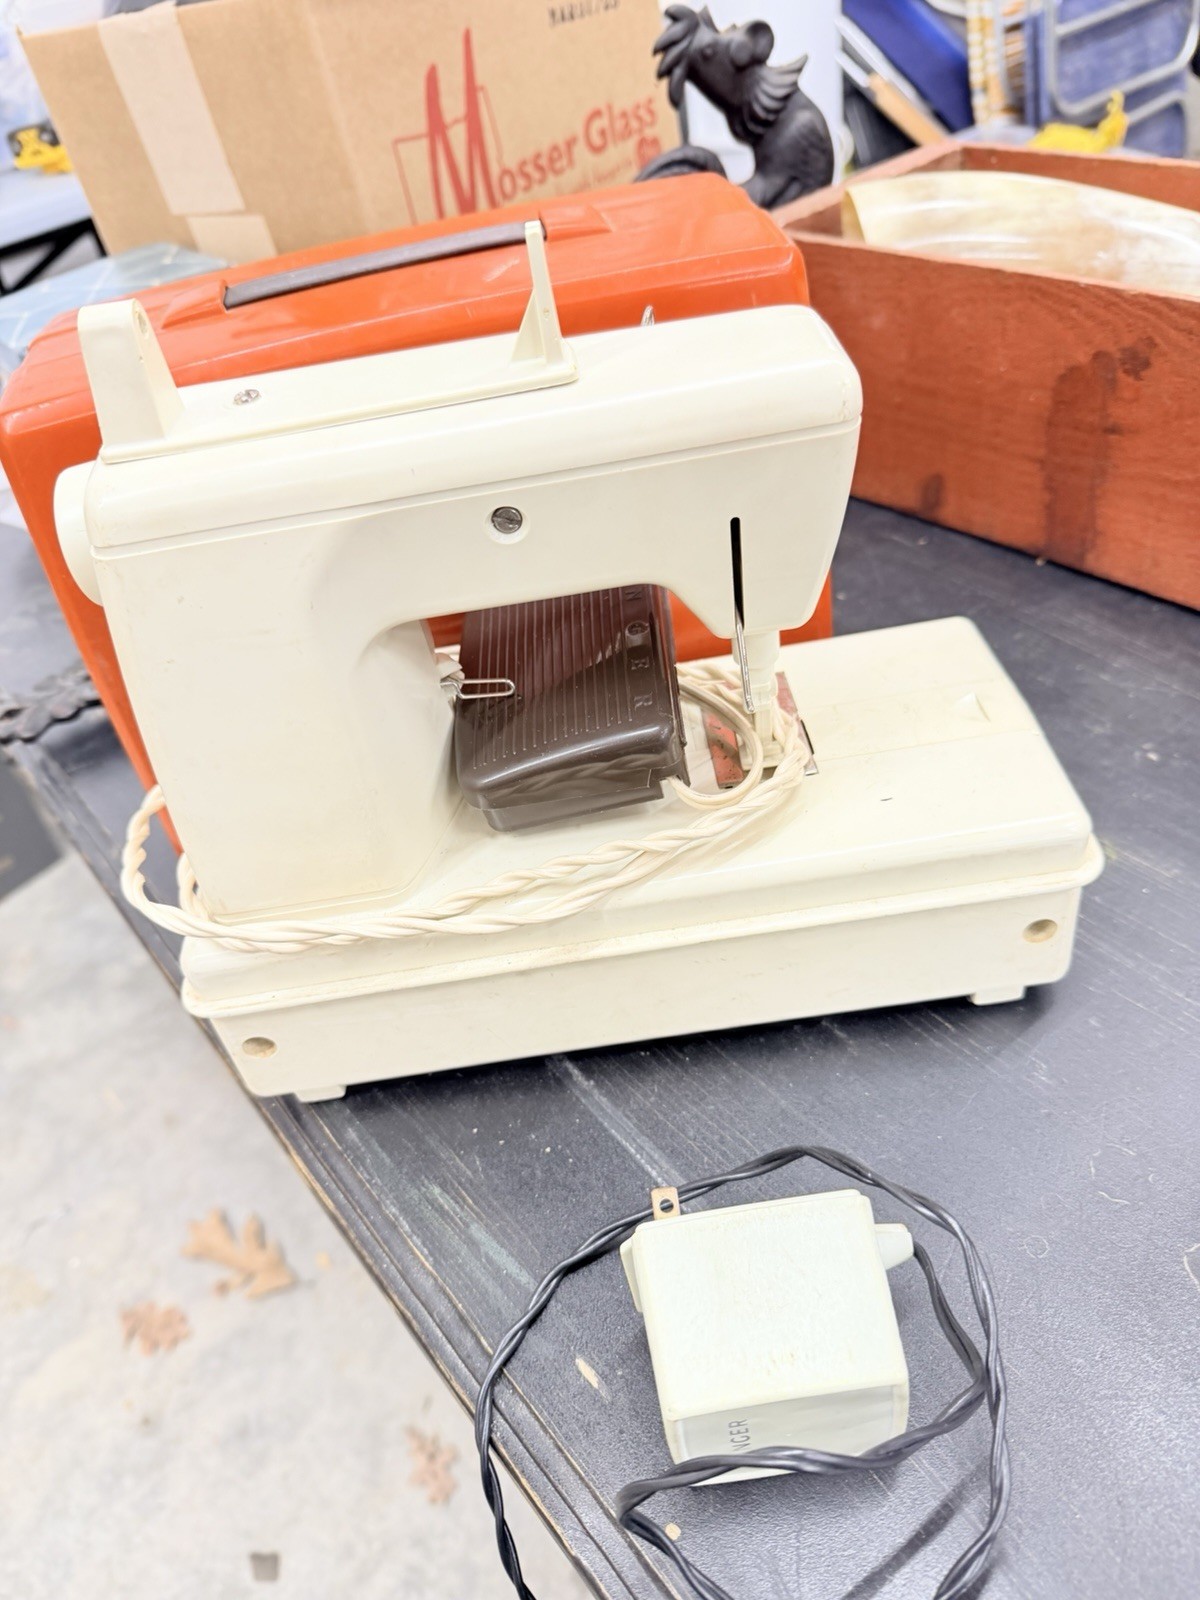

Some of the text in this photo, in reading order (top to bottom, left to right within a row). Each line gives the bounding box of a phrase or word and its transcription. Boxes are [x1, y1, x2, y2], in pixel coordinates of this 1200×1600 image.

[425, 27, 658, 219] Mosser Glass
[625, 589, 653, 709] NGER
[728, 1418, 751, 1451] NGER
